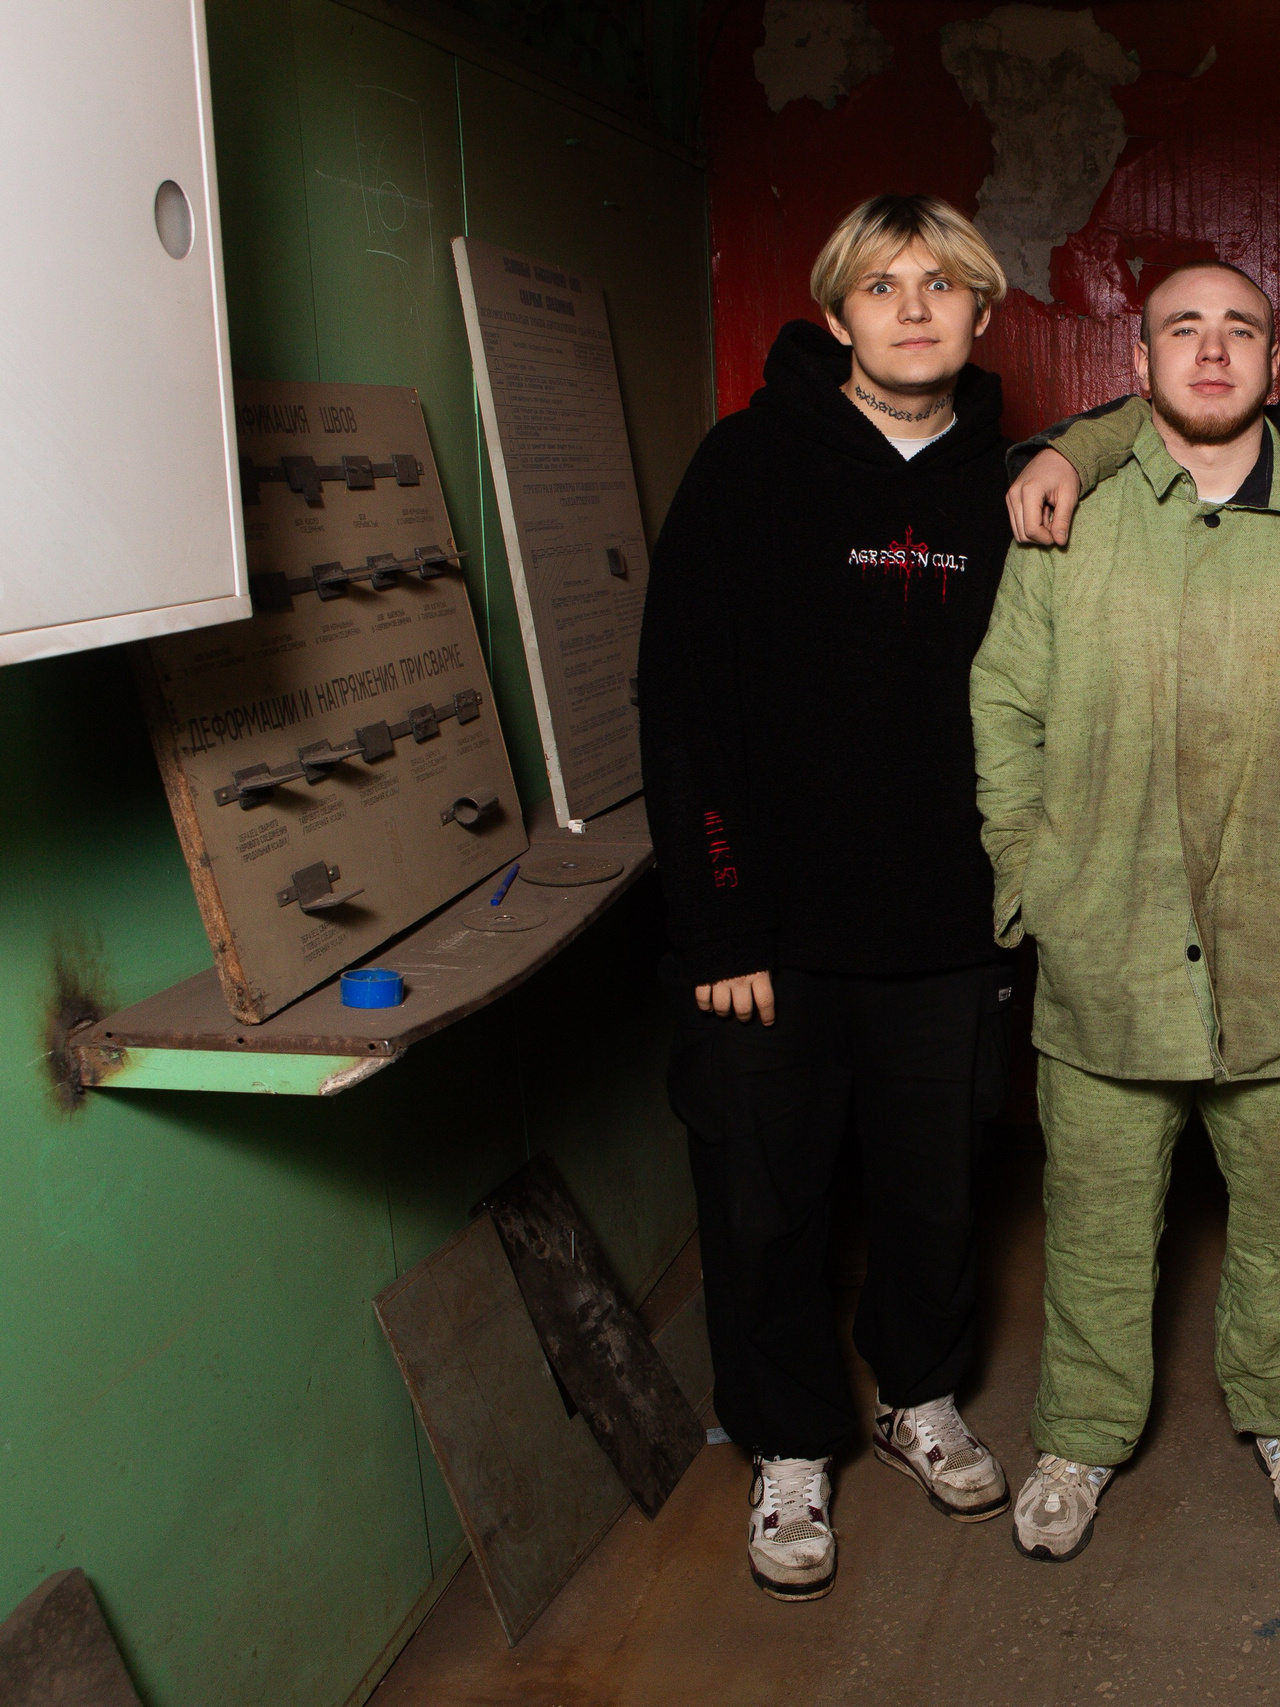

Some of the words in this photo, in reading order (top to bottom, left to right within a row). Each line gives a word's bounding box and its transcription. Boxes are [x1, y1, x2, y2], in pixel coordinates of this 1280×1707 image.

[319, 405, 358, 434] ШВОВ
[932, 552, 969, 573] CULT
[187, 692, 301, 758] ДЕФОРМАЦИИ
[299, 684, 314, 718] И
[314, 662, 400, 714] НАПРЯЖЕНИЯ
[399, 654, 426, 686] ПРИ
[422, 643, 465, 678] СВАРКЕ
